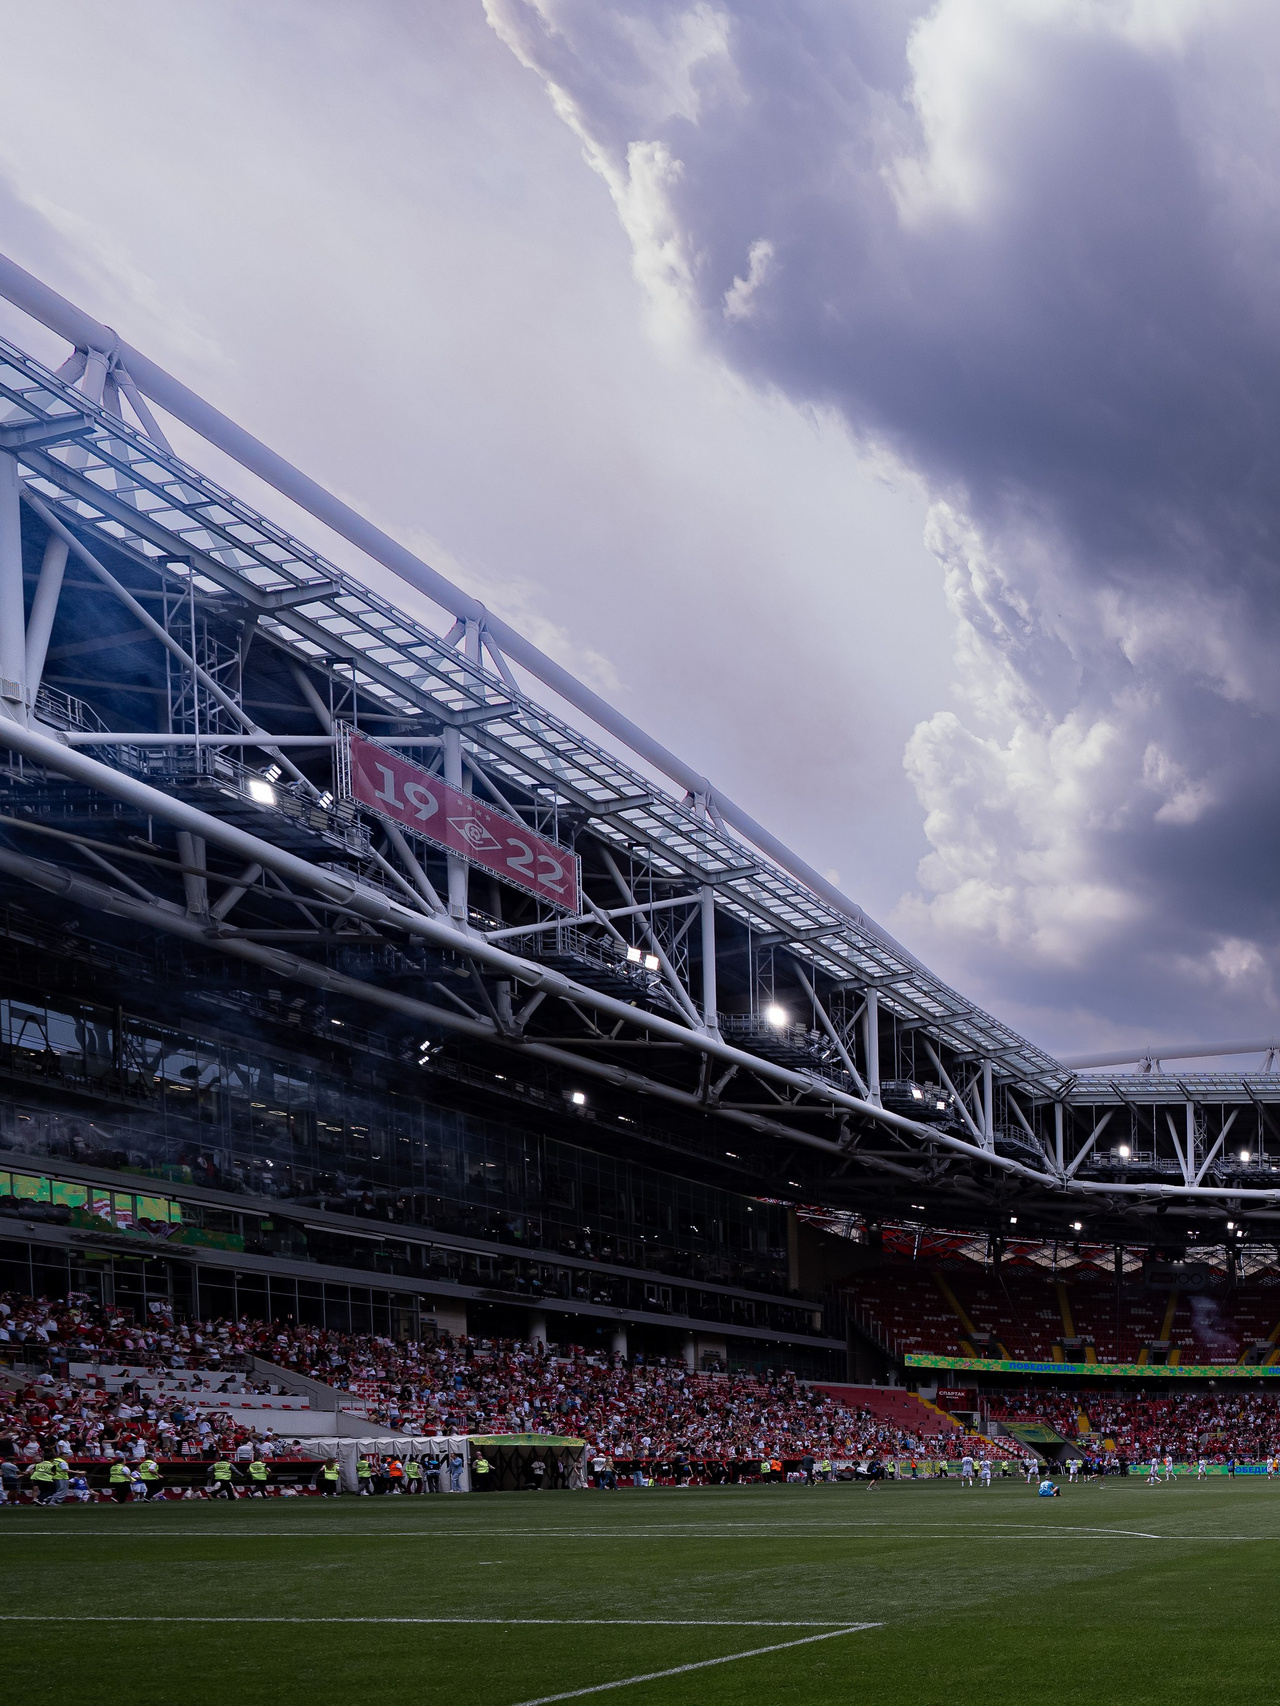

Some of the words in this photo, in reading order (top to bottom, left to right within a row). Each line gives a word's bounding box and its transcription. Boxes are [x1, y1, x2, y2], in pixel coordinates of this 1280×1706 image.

[374, 761, 439, 822] 19
[506, 838, 566, 894] 22
[1009, 1362, 1076, 1372] ПОБЕДИТЕЛЬ
